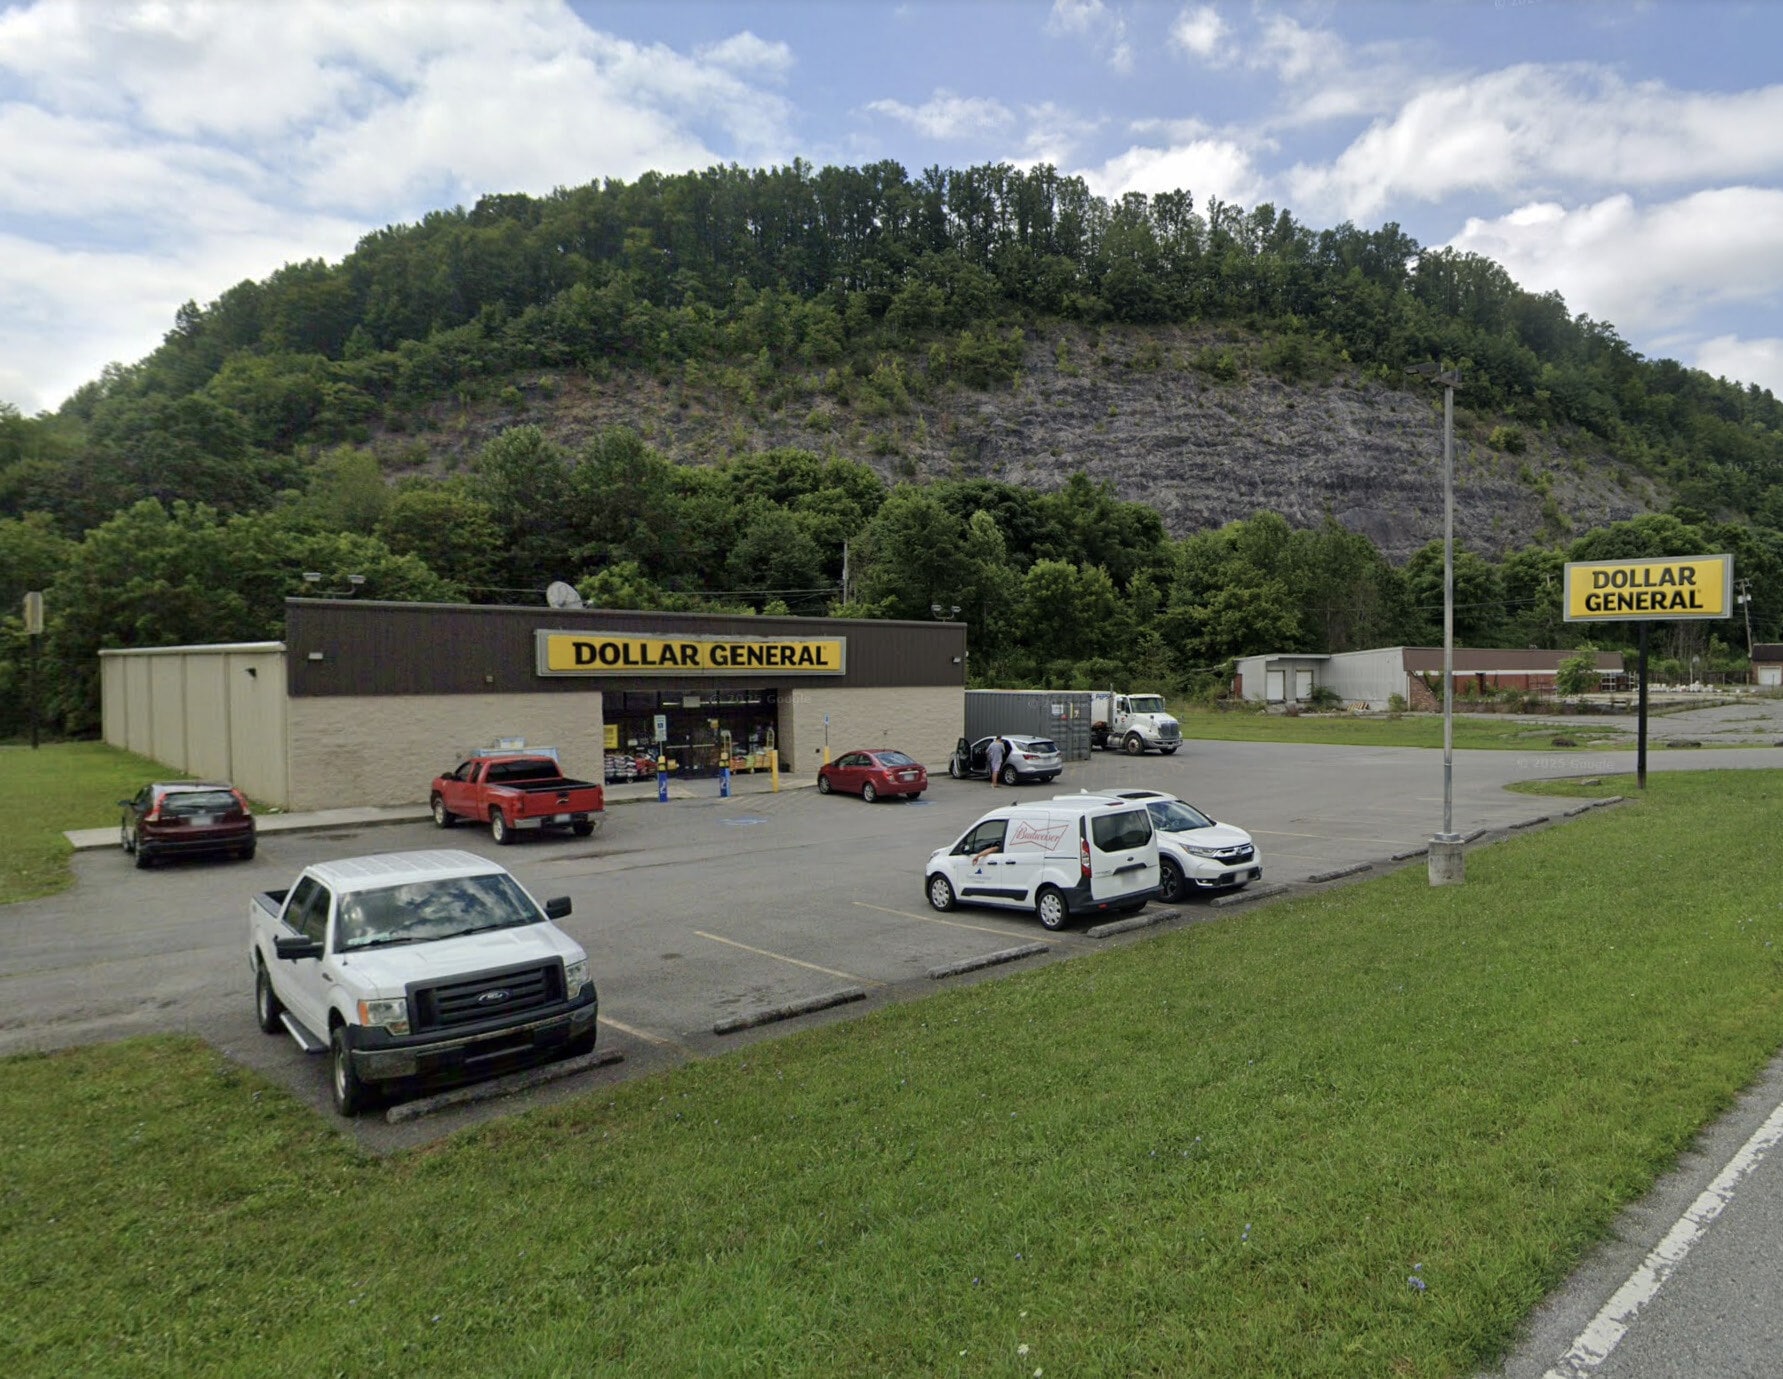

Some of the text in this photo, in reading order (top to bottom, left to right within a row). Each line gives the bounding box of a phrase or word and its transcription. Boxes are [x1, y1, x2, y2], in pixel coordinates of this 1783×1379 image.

[1592, 566, 1697, 590] DOLLAR
[1585, 590, 1704, 612] GENERAL
[572, 641, 828, 666] DOLLAR GENERAL
[1016, 826, 1060, 842] Budweiser
